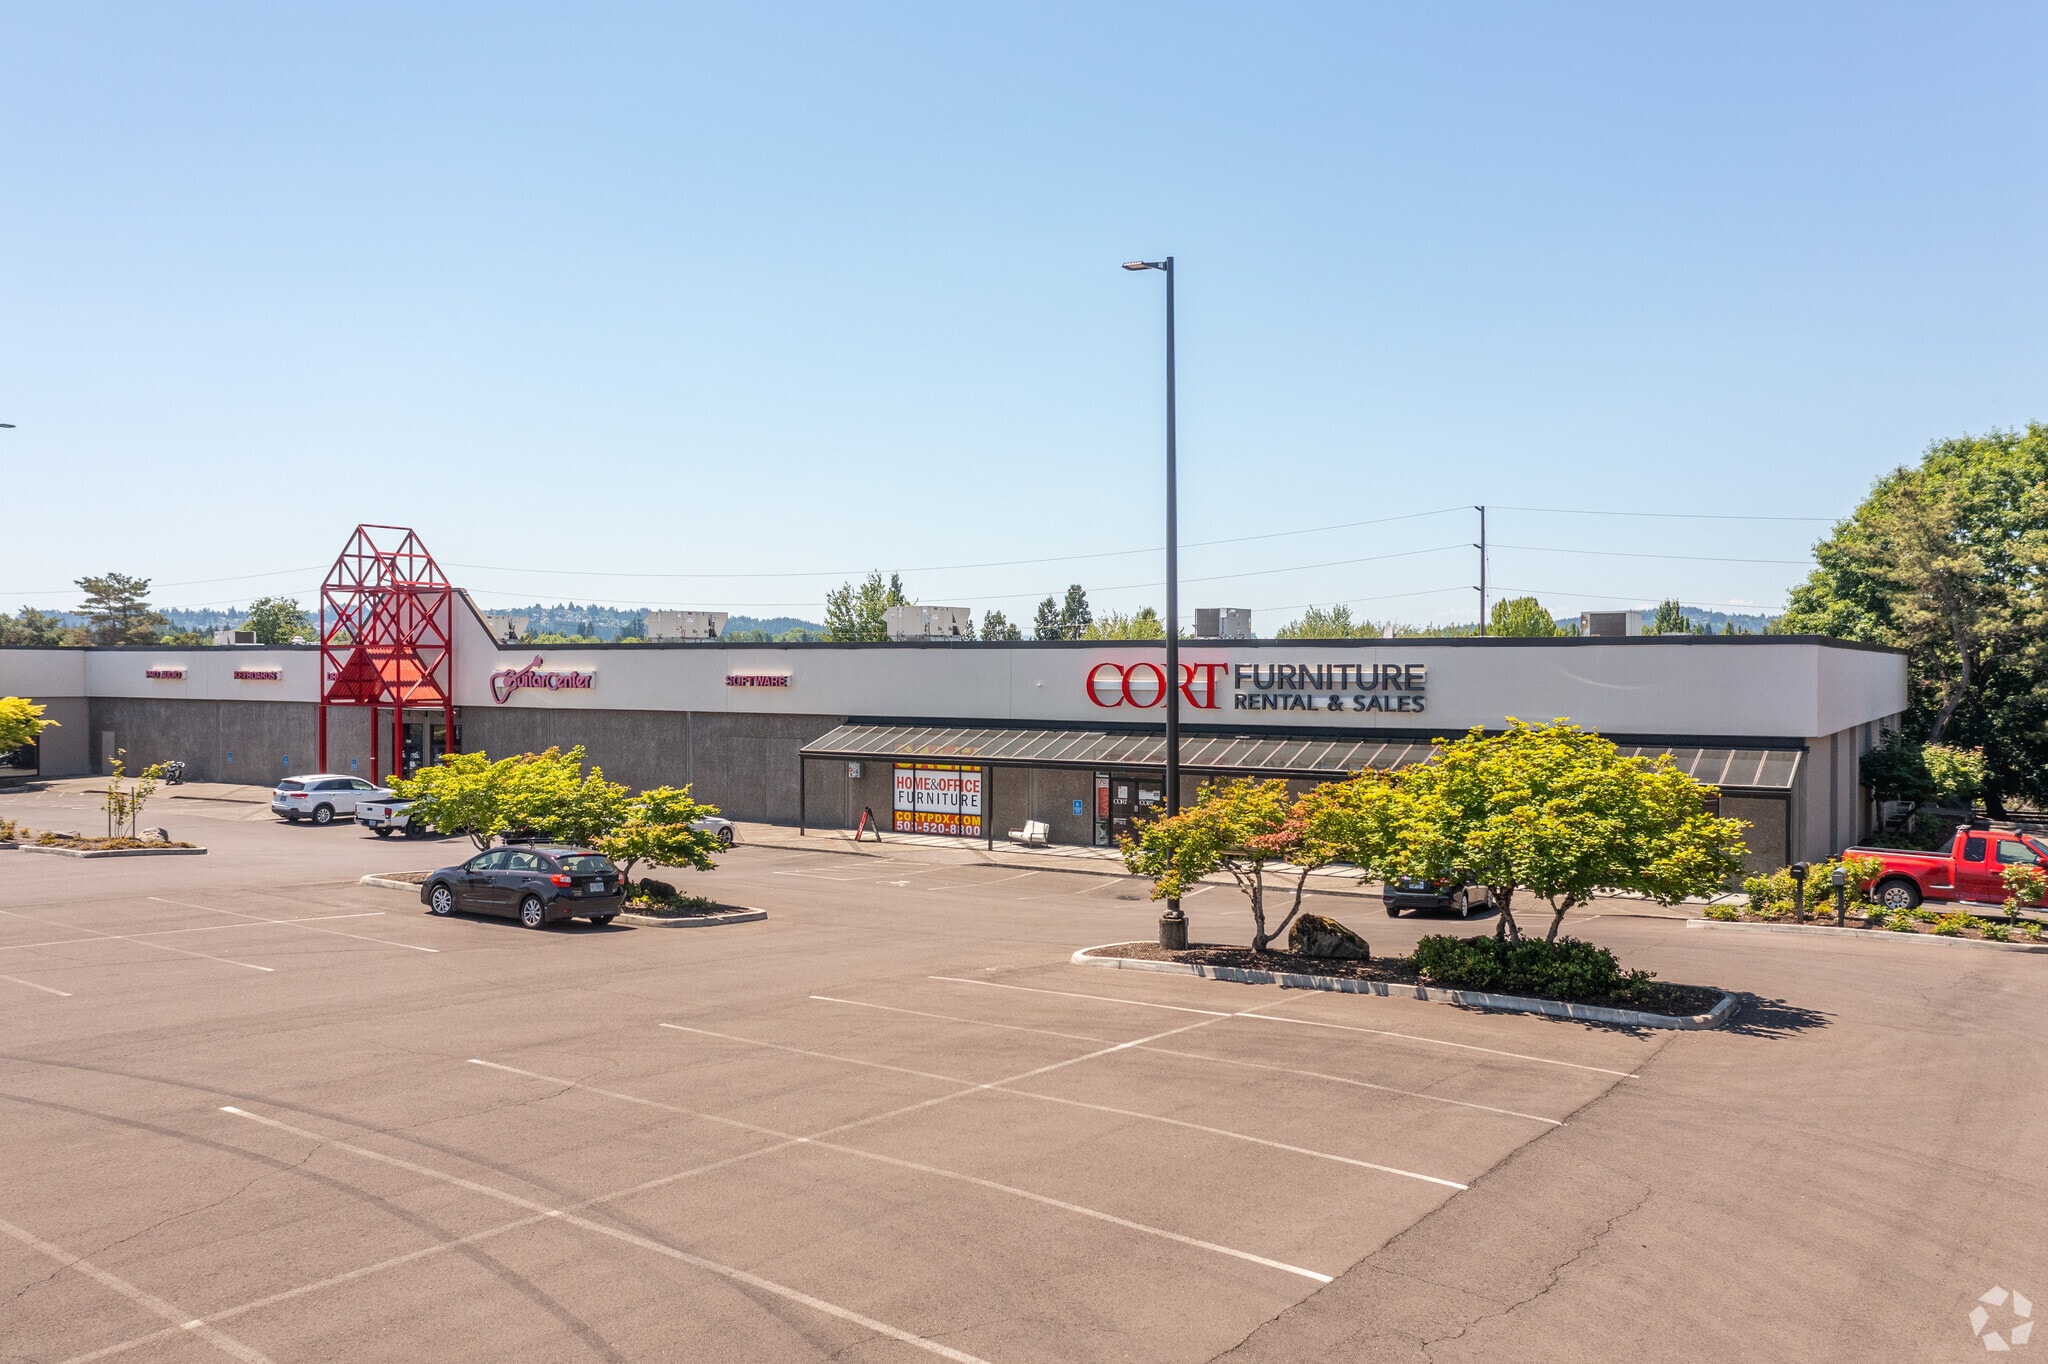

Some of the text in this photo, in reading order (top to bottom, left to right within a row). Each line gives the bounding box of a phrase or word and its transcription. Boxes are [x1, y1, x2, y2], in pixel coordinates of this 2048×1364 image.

[146, 670, 182, 679] PRO AUDIO
[233, 671, 277, 680] KEYBOARDS
[725, 675, 787, 687] SOFTWARE
[1234, 663, 1426, 691] FURNITURE
[1086, 662, 1229, 709] CORT
[1235, 693, 1425, 713] RENTAL & SALES
[898, 791, 978, 807] FURNITURE
